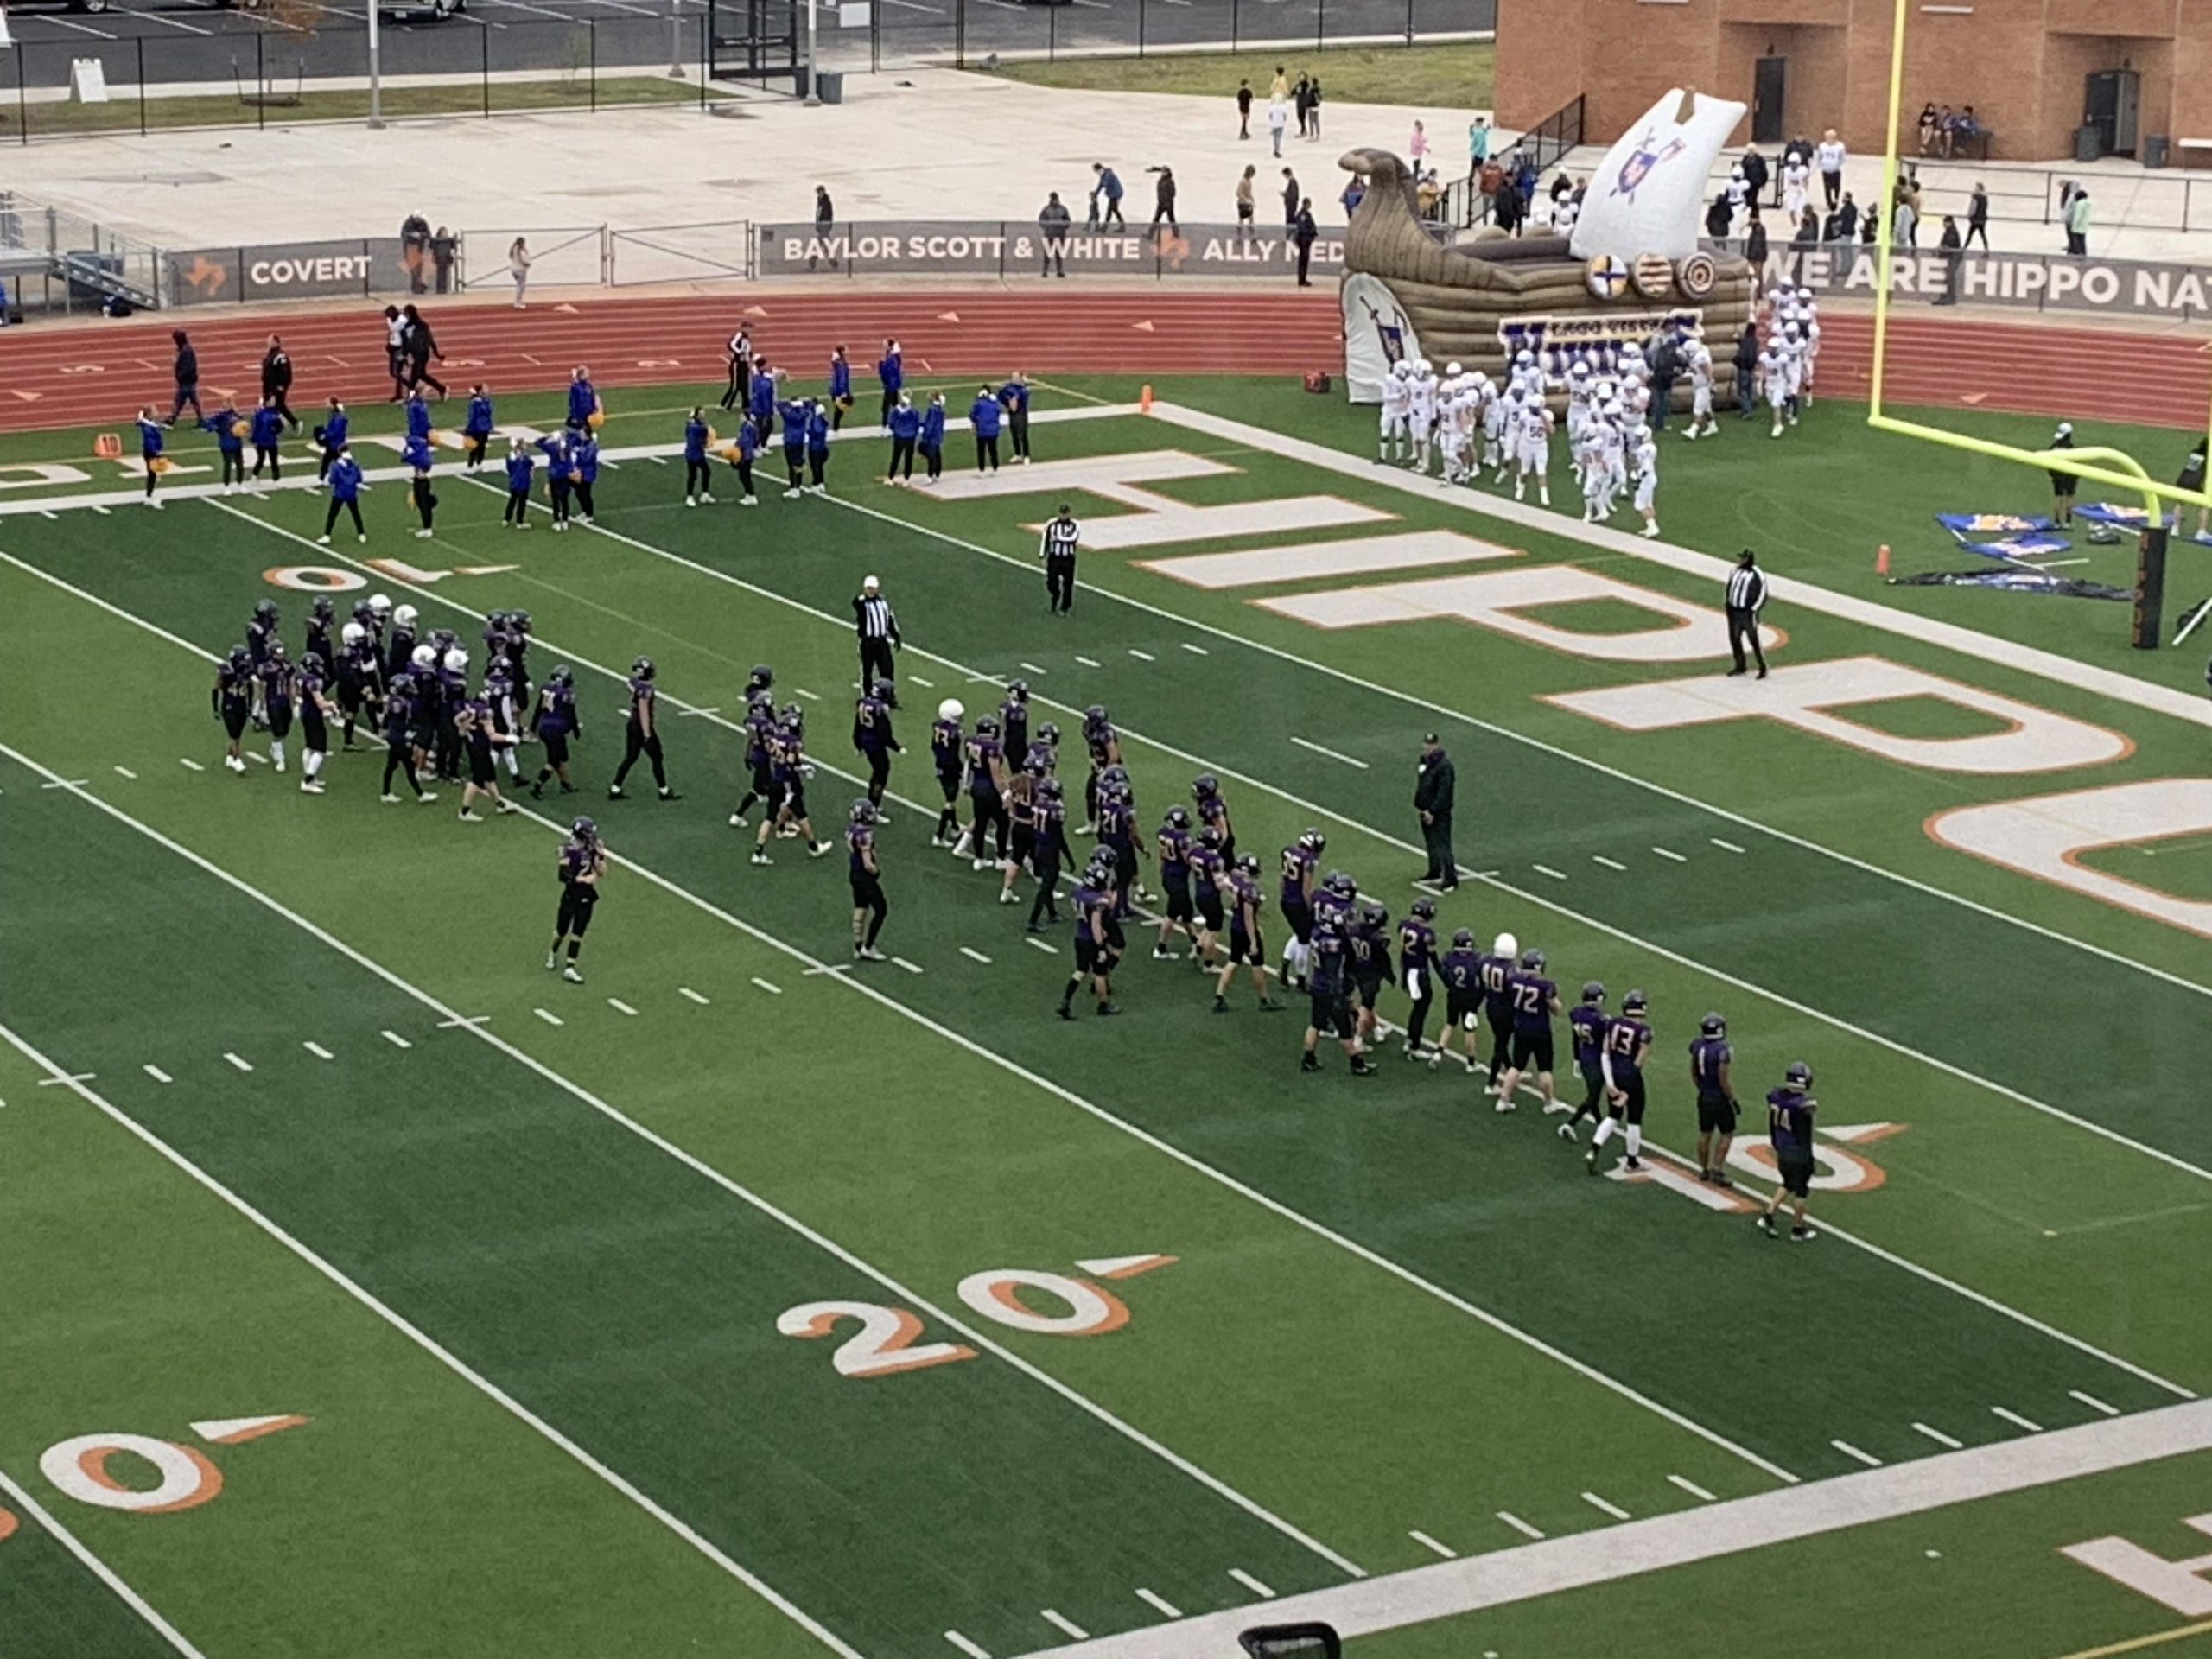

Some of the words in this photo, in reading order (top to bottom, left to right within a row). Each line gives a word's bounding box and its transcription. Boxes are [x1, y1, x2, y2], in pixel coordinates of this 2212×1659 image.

[784, 236, 900, 260] BAYLOR
[907, 236, 1006, 258] SCOTT
[1014, 236, 1033, 258] &
[1041, 237, 1141, 259] WHITE
[1202, 238, 1276, 262] ALLY
[251, 255, 372, 285] COVERT
[1844, 253, 1949, 294] ARE
[1964, 260, 2119, 303] HIPPO
[102, 436, 118, 453] 10
[1454, 965, 1467, 988] 2
[1511, 982, 1540, 1014] 72
[1611, 1024, 1636, 1057] 13
[1603, 1135, 1887, 1214] 10
[777, 1268, 1130, 1377] 20
